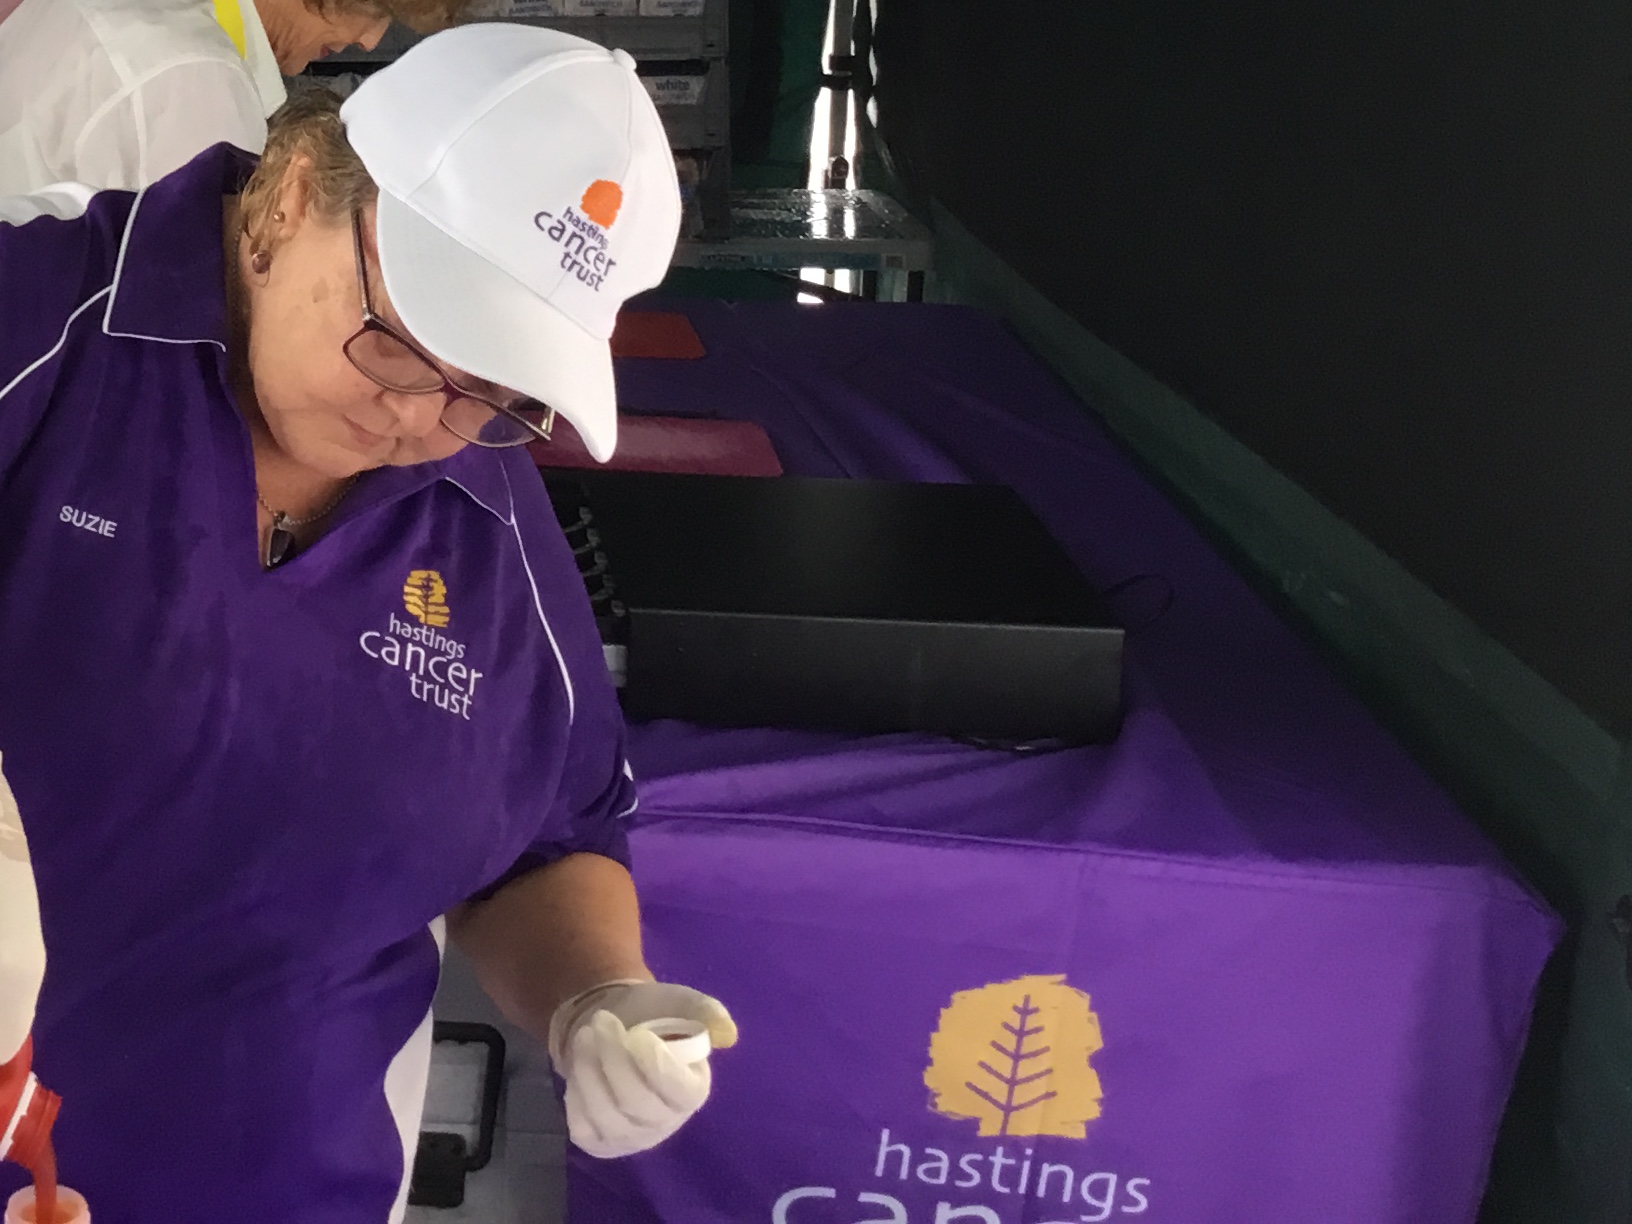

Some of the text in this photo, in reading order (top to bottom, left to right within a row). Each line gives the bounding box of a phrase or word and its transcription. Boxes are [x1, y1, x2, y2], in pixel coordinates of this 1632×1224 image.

[655, 79, 690, 91] white
[534, 211, 616, 277] cancer
[559, 251, 604, 292] trust
[59, 505, 118, 538] SUZIE
[388, 612, 466, 660] hastings
[359, 631, 483, 697] cancer
[409, 672, 473, 721] trust
[874, 1128, 1151, 1222] hastings
